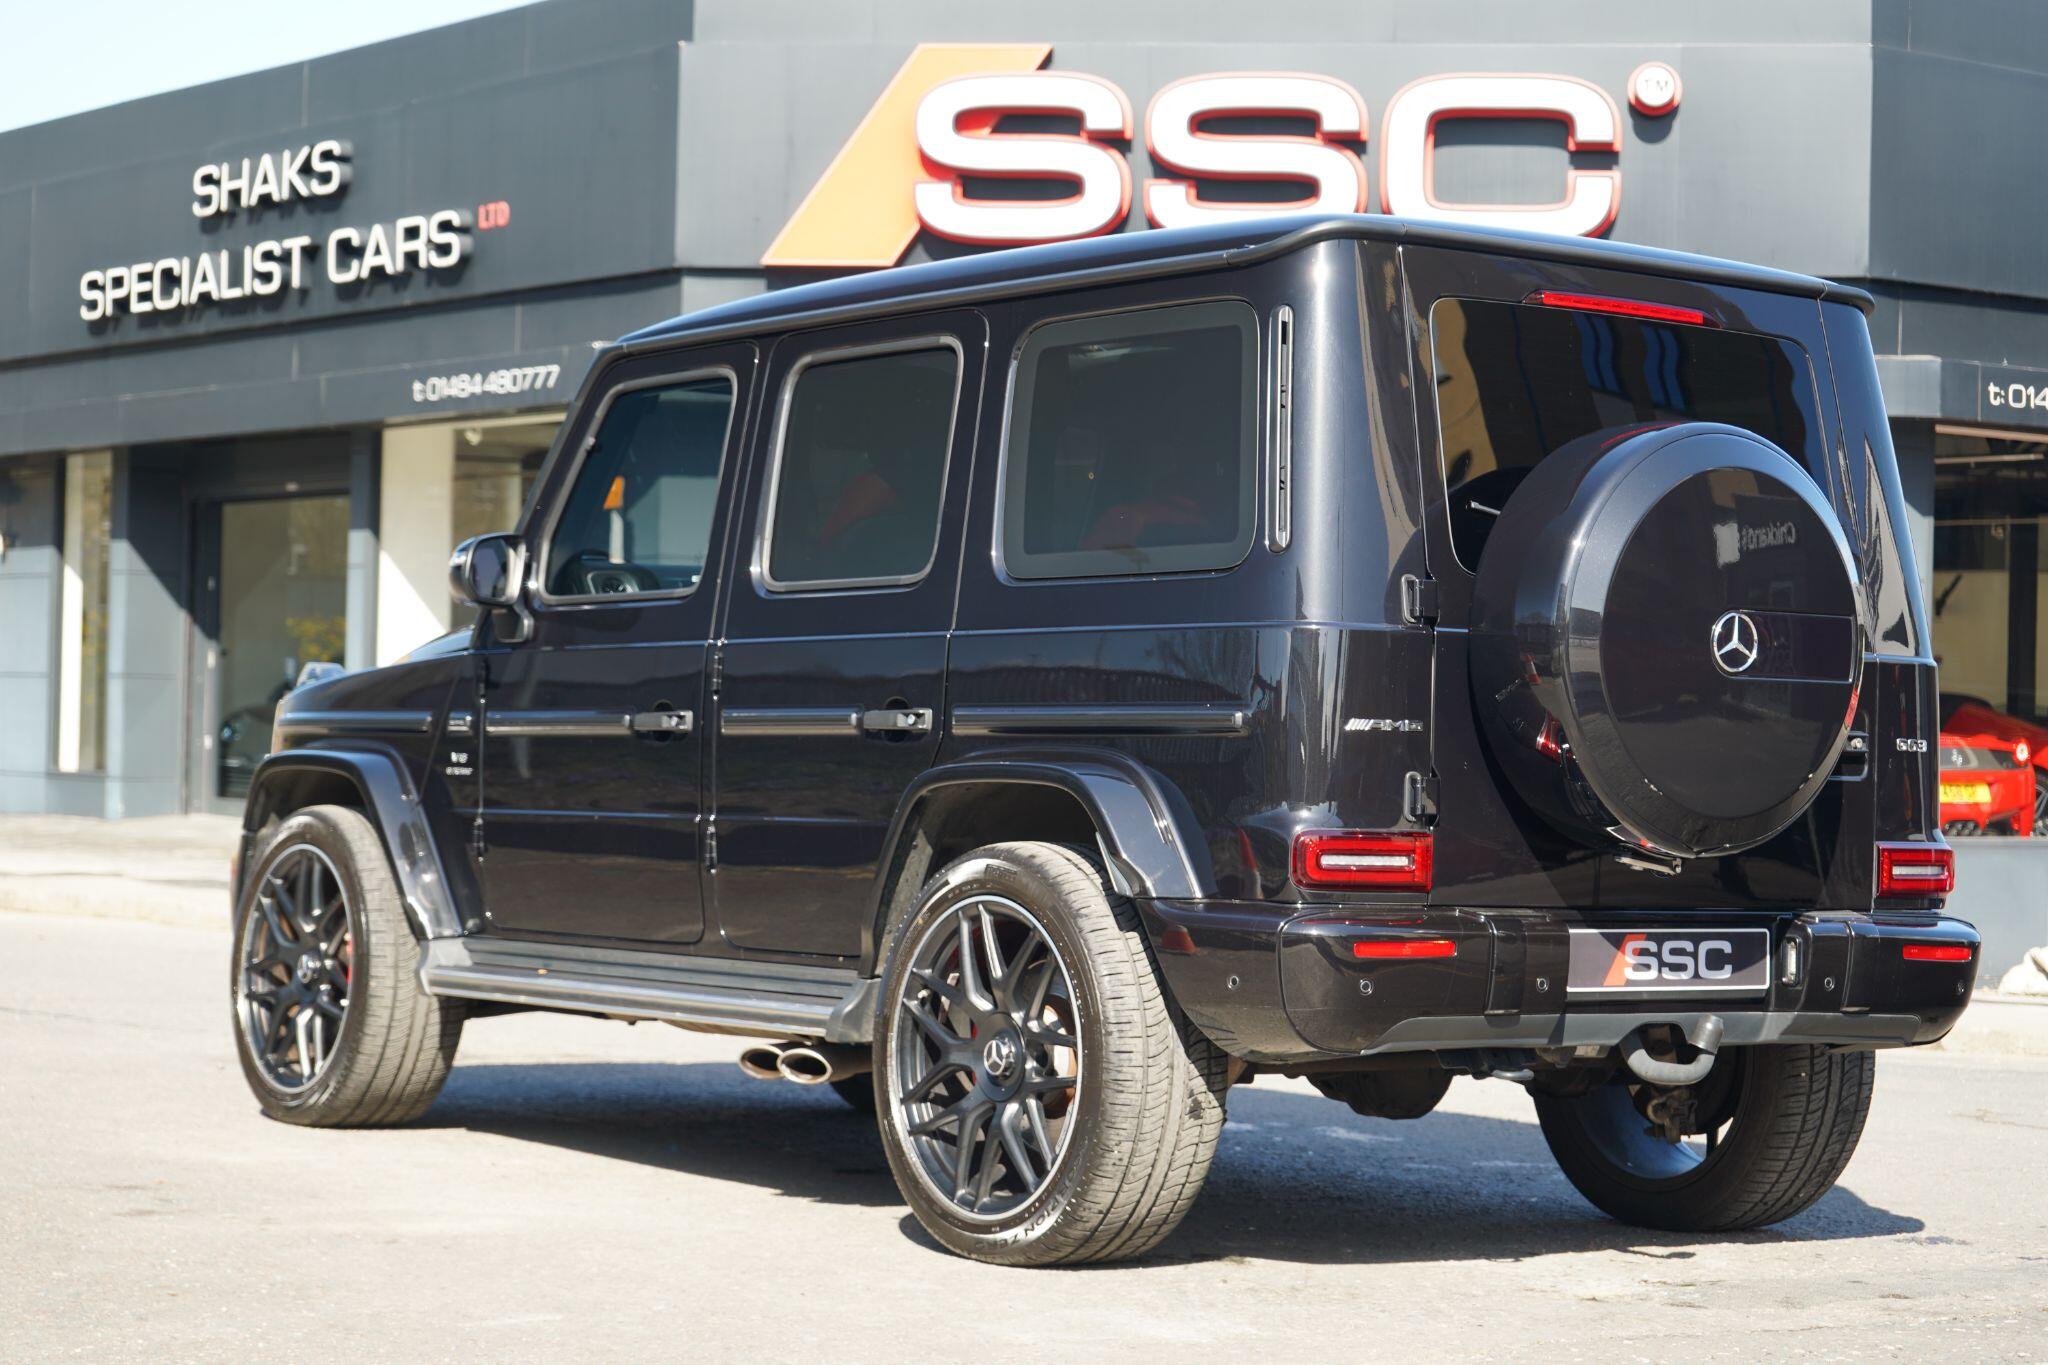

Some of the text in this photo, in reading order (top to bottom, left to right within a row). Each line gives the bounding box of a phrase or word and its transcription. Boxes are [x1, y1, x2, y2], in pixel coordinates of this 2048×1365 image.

[192, 139, 342, 218] SHAKS
[916, 71, 1623, 245] SSC
[79, 200, 511, 321] SPECIALIST CARS LTD
[1623, 940, 1733, 981] SSC
